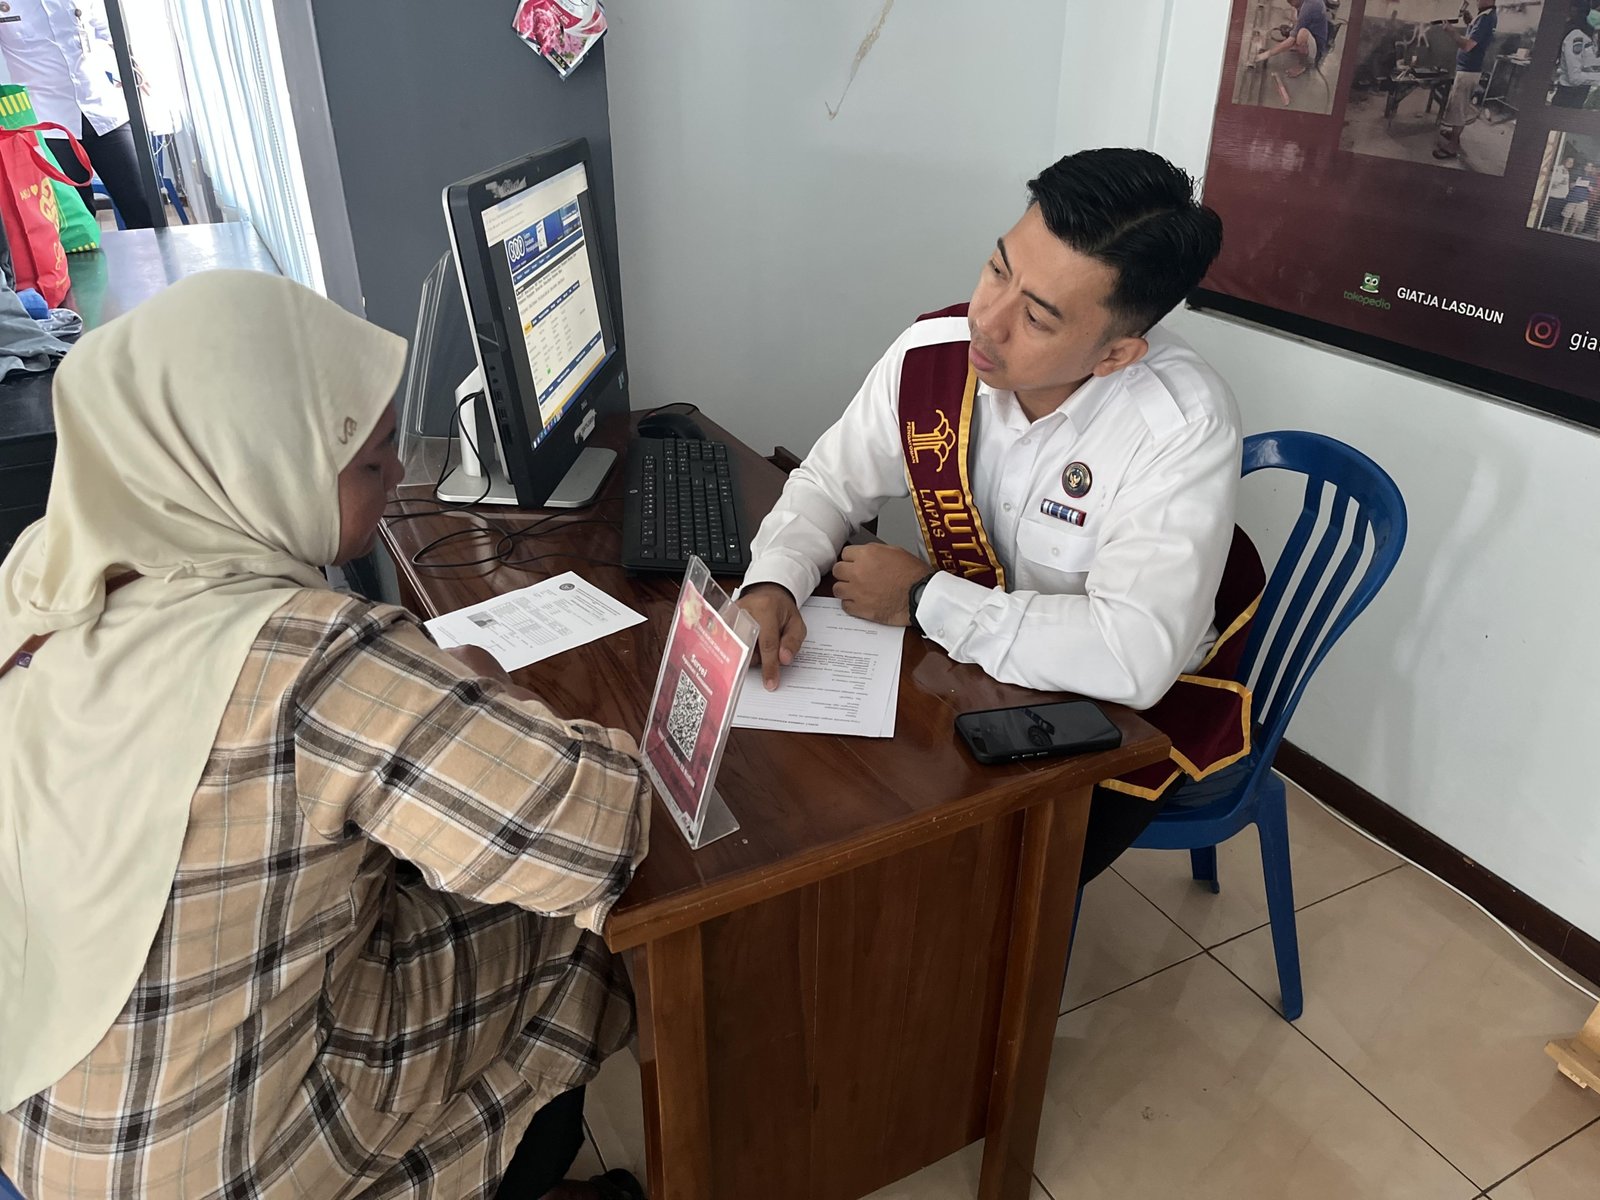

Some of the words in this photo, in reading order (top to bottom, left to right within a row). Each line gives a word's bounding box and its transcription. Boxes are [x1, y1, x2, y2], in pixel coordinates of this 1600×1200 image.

[1343, 290, 1391, 310] tokopedia
[1397, 287, 1439, 308] GIATJA
[1441, 298, 1504, 324] LASDAUN
[1569, 331, 1600, 351] gia
[906, 421, 917, 464] PENGAYOMAN
[919, 489, 946, 538] LAPAS
[934, 489, 991, 577] DUTA
